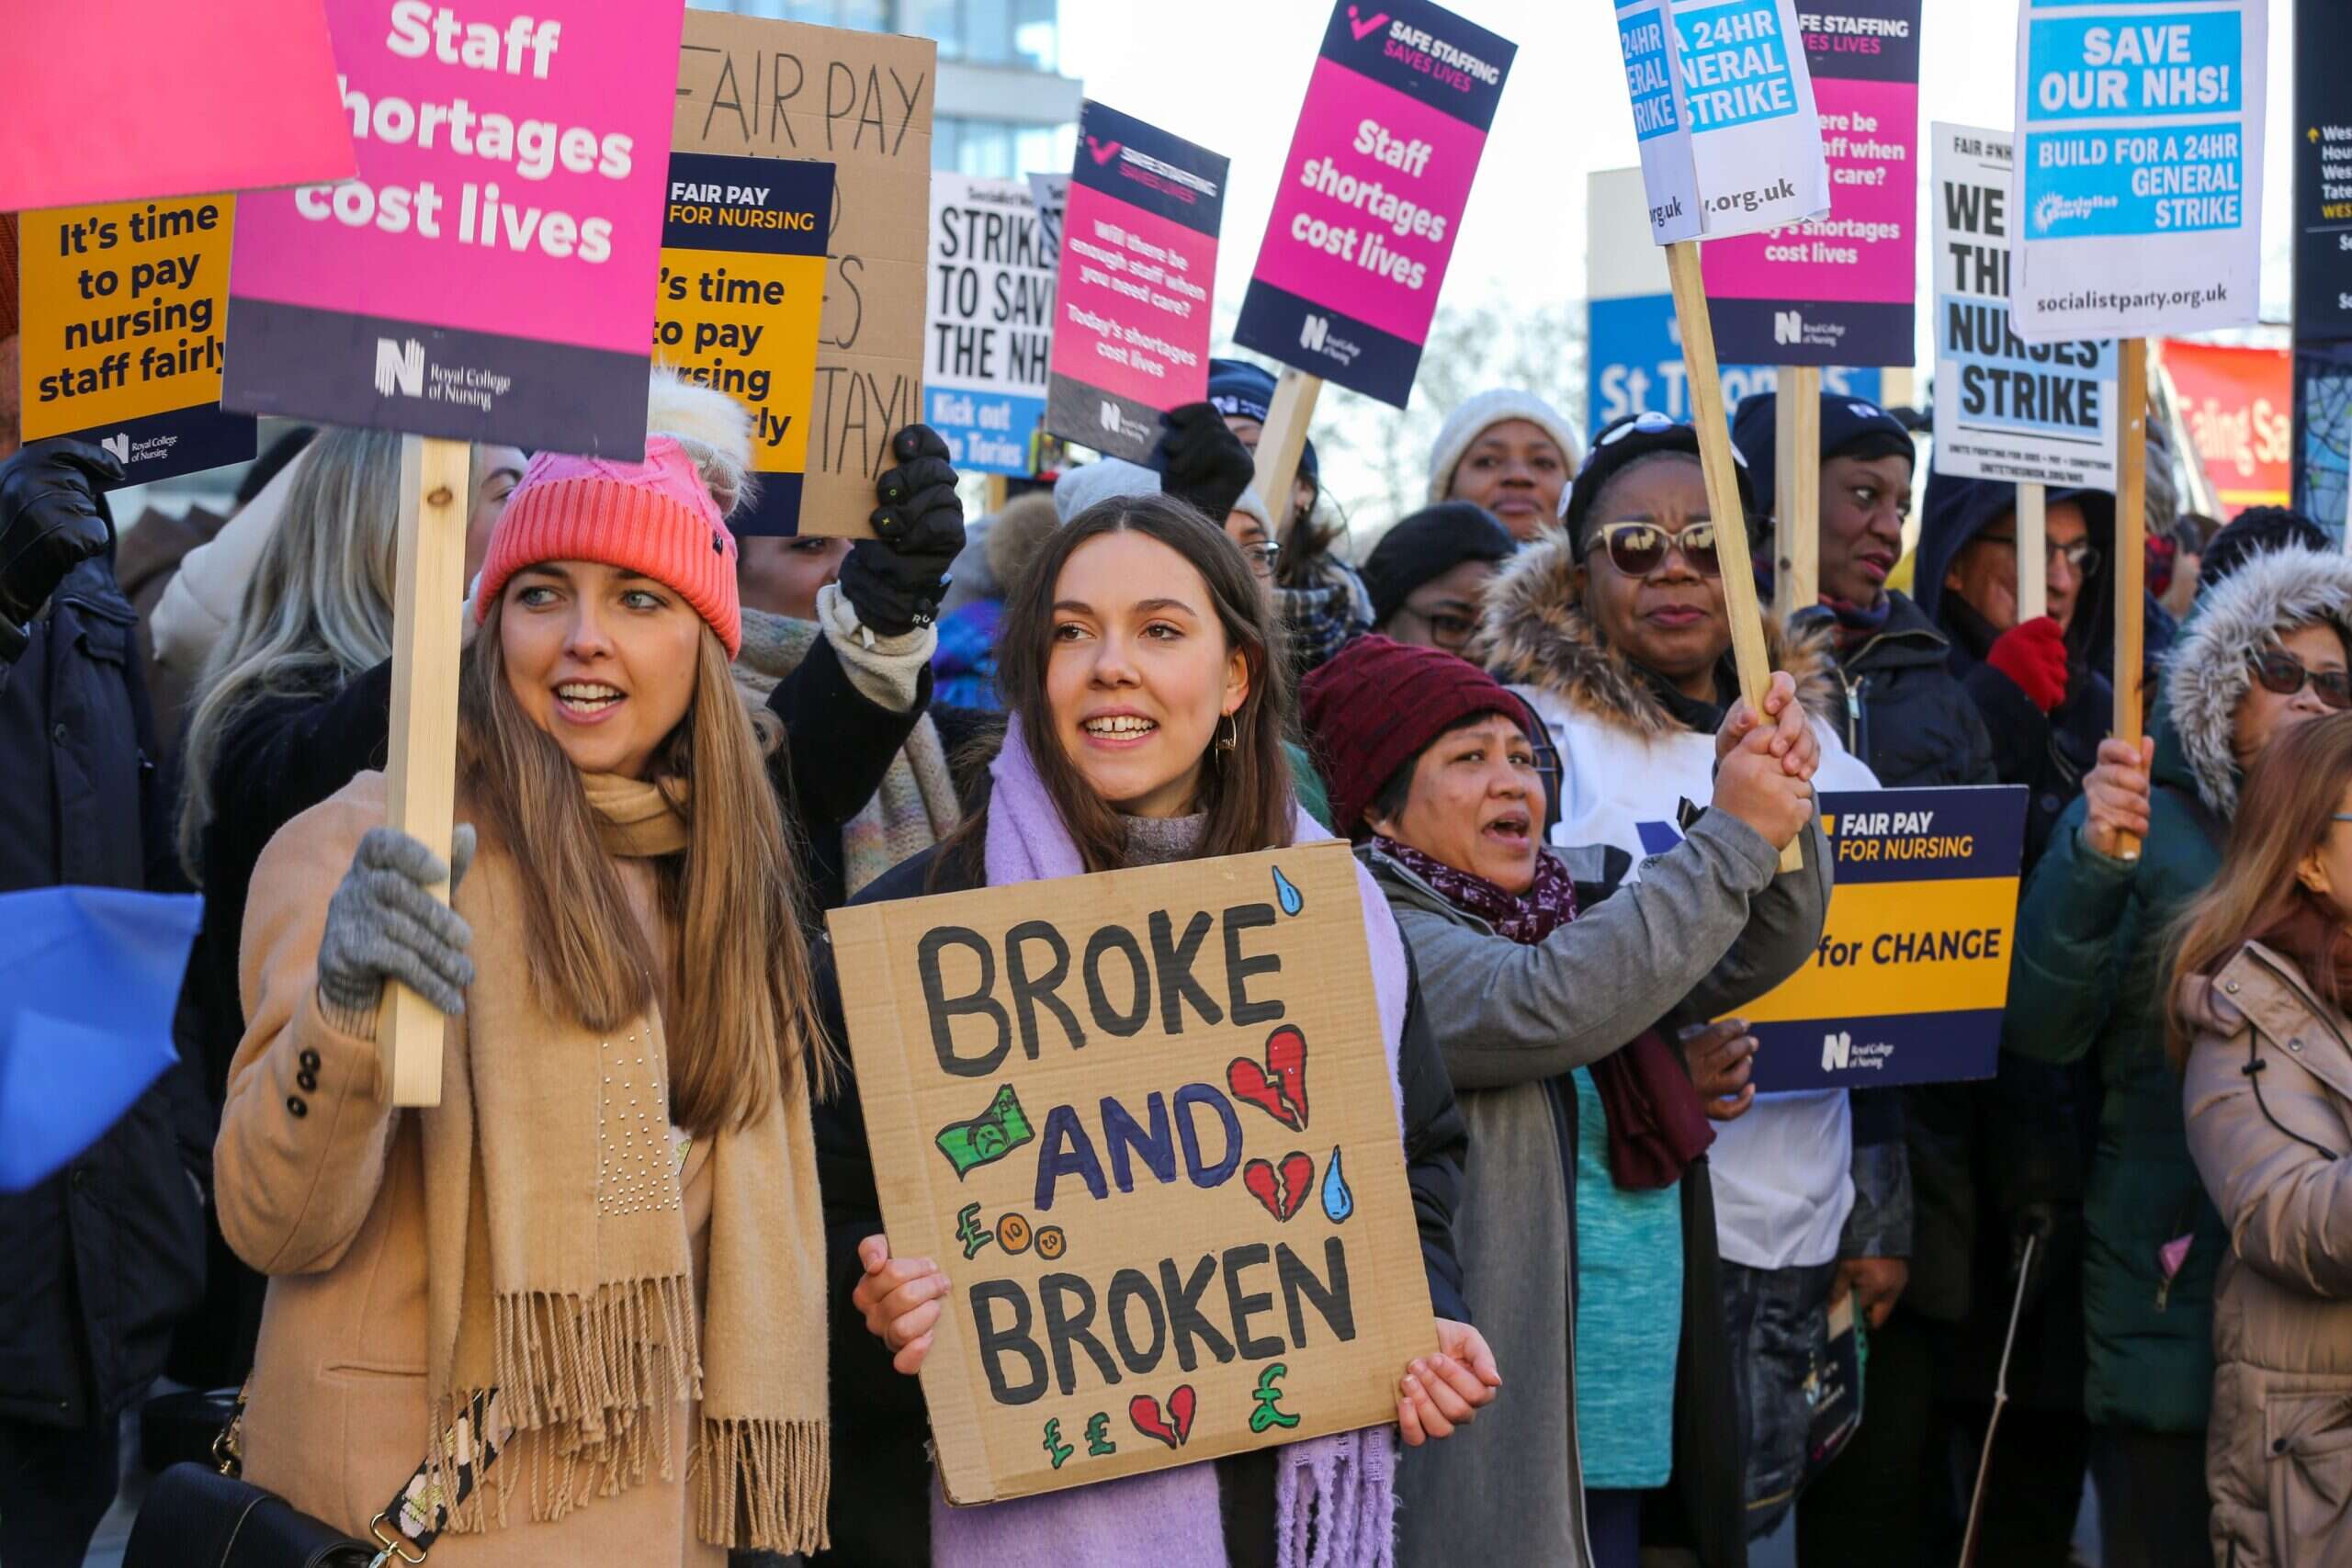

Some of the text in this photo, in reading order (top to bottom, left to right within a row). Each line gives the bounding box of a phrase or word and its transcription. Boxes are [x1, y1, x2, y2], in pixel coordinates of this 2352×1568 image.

[386, 0, 561, 79] Staff
[1621, 23, 1663, 60] 24HR
[1693, 9, 1777, 51] 24HR
[1798, 14, 1909, 38] FE STAFFING
[1834, 37, 1882, 55] LIVES
[2082, 25, 2191, 66] SAVE
[1383, 39, 1472, 93] SAVES LIVES
[1389, 19, 1500, 85] SAFE STAFFING
[1679, 43, 1785, 89] NERAL
[1625, 57, 1669, 97] ERAL
[2039, 64, 2230, 112] OUR NHS!
[337, 73, 633, 180] hortages
[827, 62, 924, 156] PAY
[1632, 94, 1676, 134] RIKE
[1819, 111, 1878, 132] ere be
[1352, 118, 1433, 179] Staff
[1822, 137, 1905, 161] aff when
[1954, 136, 1983, 158] FAIR
[2039, 133, 2238, 168] BUILD FOR A 24HR
[670, 182, 770, 206] FAIR PAY
[1834, 166, 1886, 186] care?
[2131, 163, 2239, 197] GENERAL
[668, 205, 814, 231] FOR NURSING
[1300, 157, 1448, 243] shortages
[1944, 181, 2005, 237] WE
[2154, 195, 2238, 229] STRIKE
[60, 204, 219, 256] It's time
[295, 181, 613, 264] cost lives
[1291, 213, 1427, 290] cost lives
[1765, 242, 1858, 265] cost lives
[78, 254, 201, 299] to pay
[661, 267, 785, 305] 's time
[937, 264, 1056, 329] TO SAV
[2037, 282, 2227, 313] socialistparty.org.uk
[64, 297, 213, 350] nursing
[694, 322, 763, 356] pay
[935, 323, 1049, 385] THE NH
[1095, 341, 1165, 378] cost lives
[1124, 326, 1198, 367] shortages
[39, 352, 130, 402] staff
[431, 364, 511, 395] Royal College
[675, 357, 771, 401] rsing
[1600, 362, 1651, 423] St
[1962, 365, 2098, 428] STRIKE
[428, 384, 492, 412] of Nursing
[978, 402, 1011, 429] out
[131, 435, 177, 451] Royal College
[140, 446, 169, 460] Nursing
[1841, 811, 1934, 837] FAIR PAY
[1838, 836, 1973, 862] FOR NURSING
[1818, 929, 2001, 967] for CHANGE
[917, 903, 1285, 1077] BROKE
[1034, 1083, 1243, 1211] AND
[969, 1235, 1356, 1405] BROKEN
